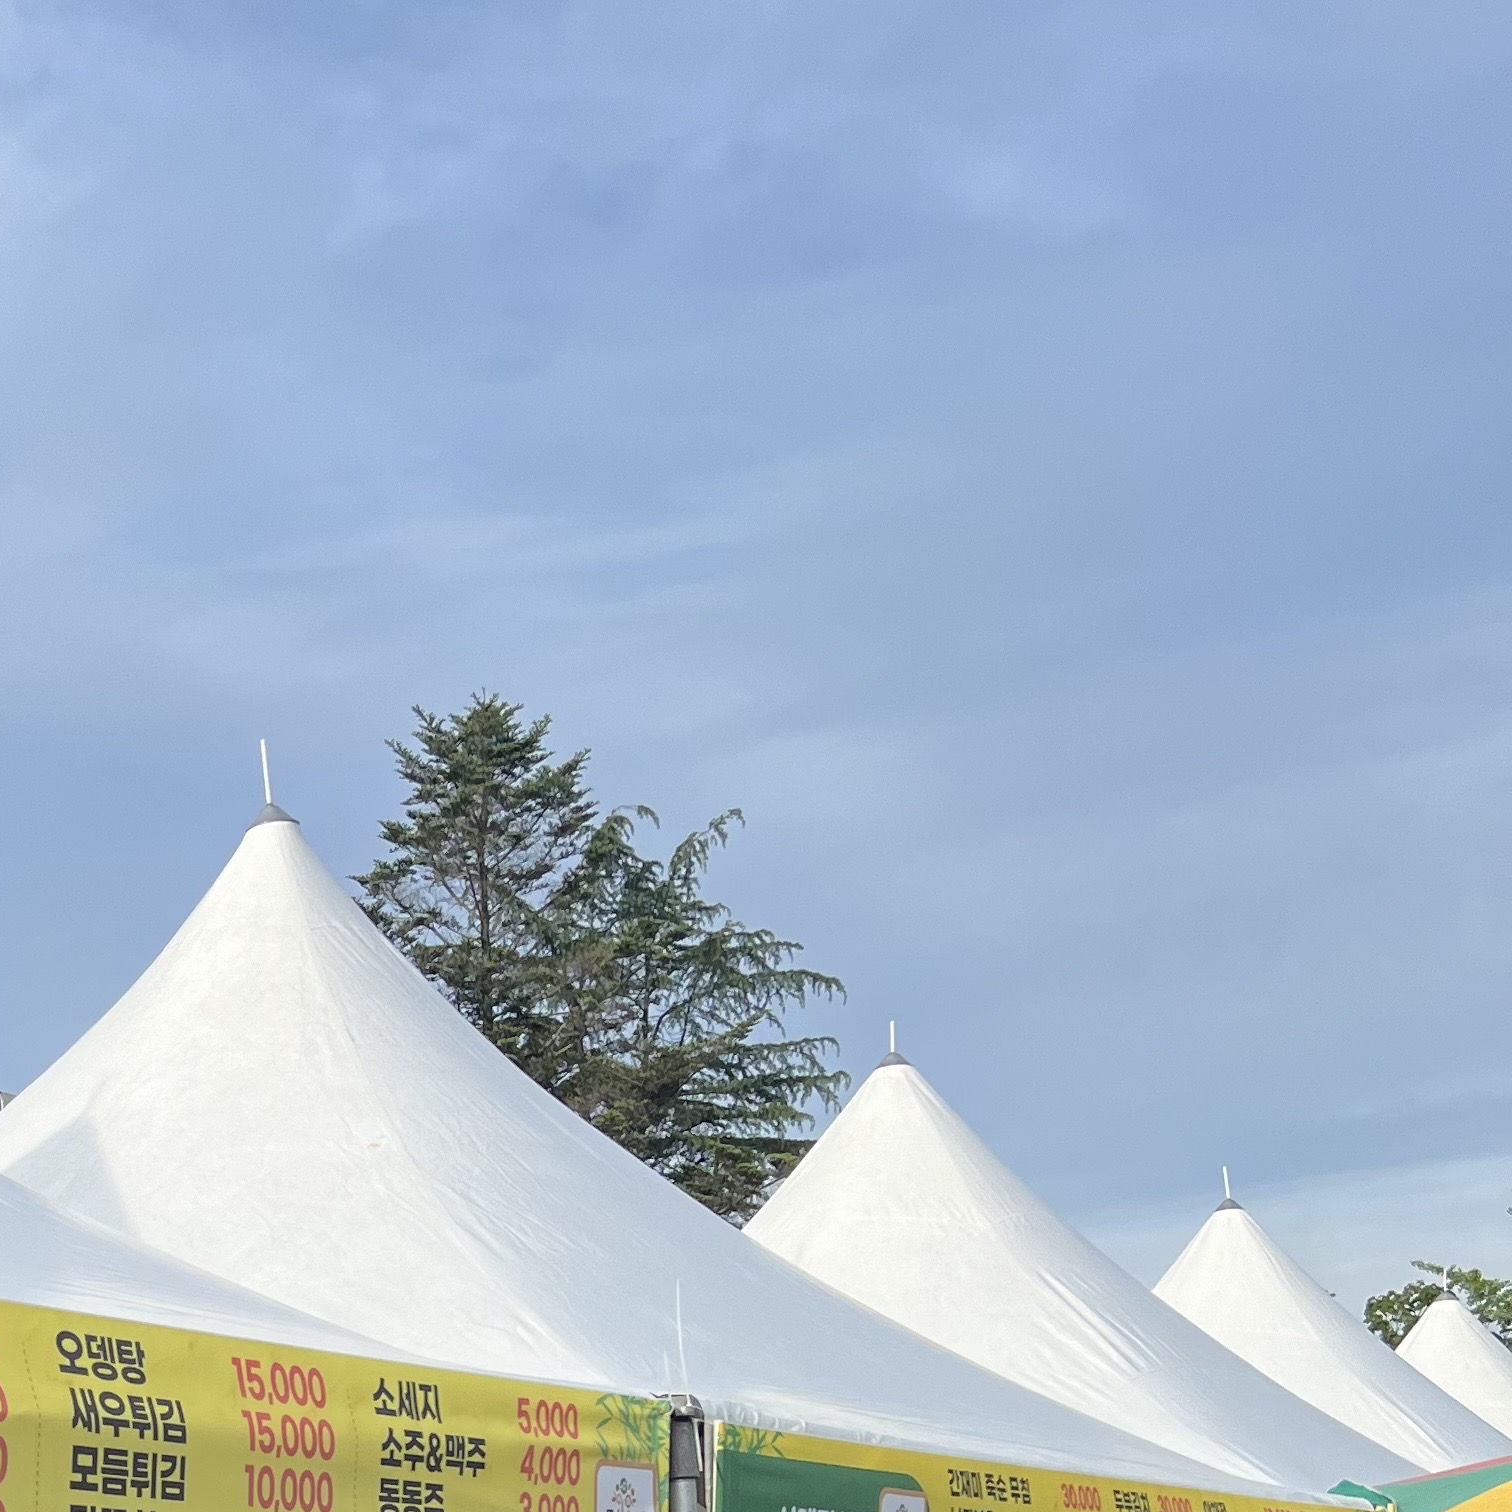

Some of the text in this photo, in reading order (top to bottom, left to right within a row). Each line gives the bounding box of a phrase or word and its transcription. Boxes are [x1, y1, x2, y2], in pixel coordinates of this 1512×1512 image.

[55, 1329, 328, 1410] 오뎅탕 15,000
[70, 1387, 336, 1462] 새우튀김 15,000
[372, 1377, 579, 1440] 소세지 5,000
[68, 1445, 186, 1501] 모듬튀김
[379, 1428, 581, 1487] 소주&맥주 4,000
[985, 1473, 1008, 1502] 죽순
[1009, 1476, 1032, 1505] 무침
[1061, 1483, 1101, 1512] 30,000
